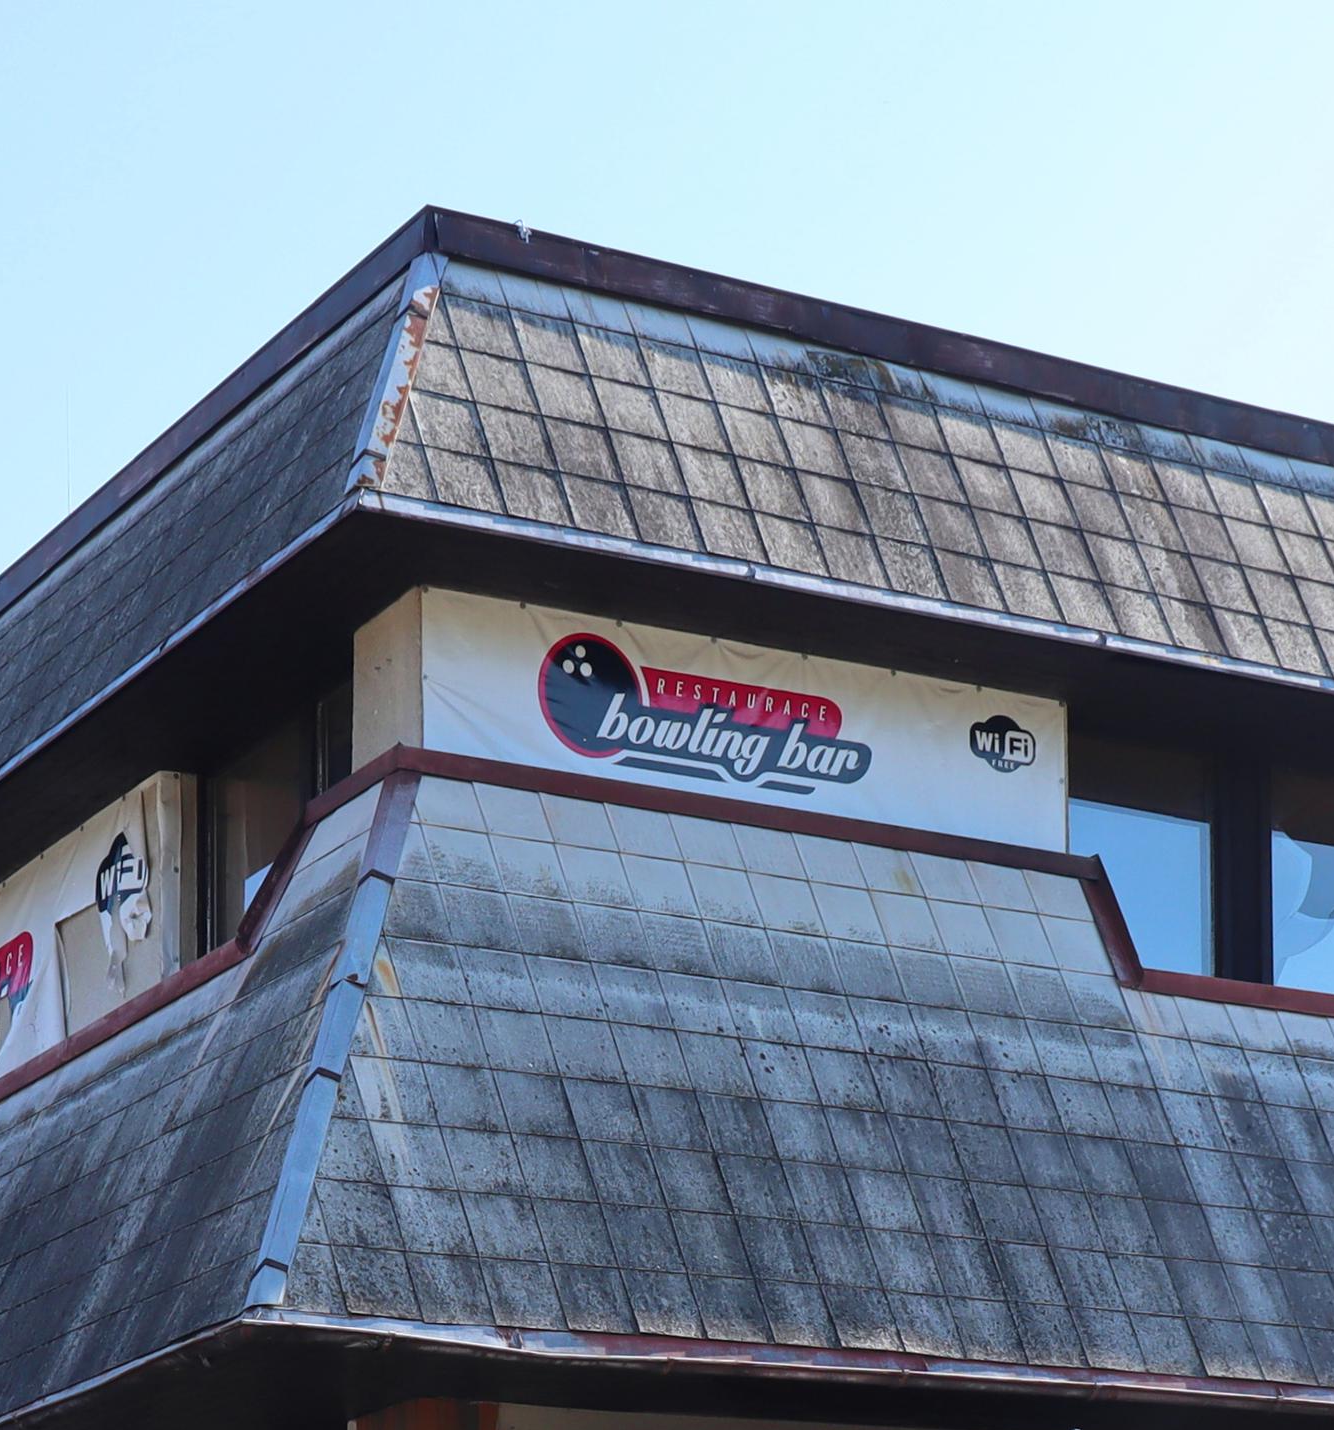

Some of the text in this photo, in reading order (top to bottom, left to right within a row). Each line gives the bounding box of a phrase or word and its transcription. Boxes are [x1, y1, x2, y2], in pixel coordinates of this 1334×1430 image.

[656, 678, 827, 722] RESTAURACE
[596, 692, 860, 777] bowling bar
[991, 759, 1015, 770] FREE
